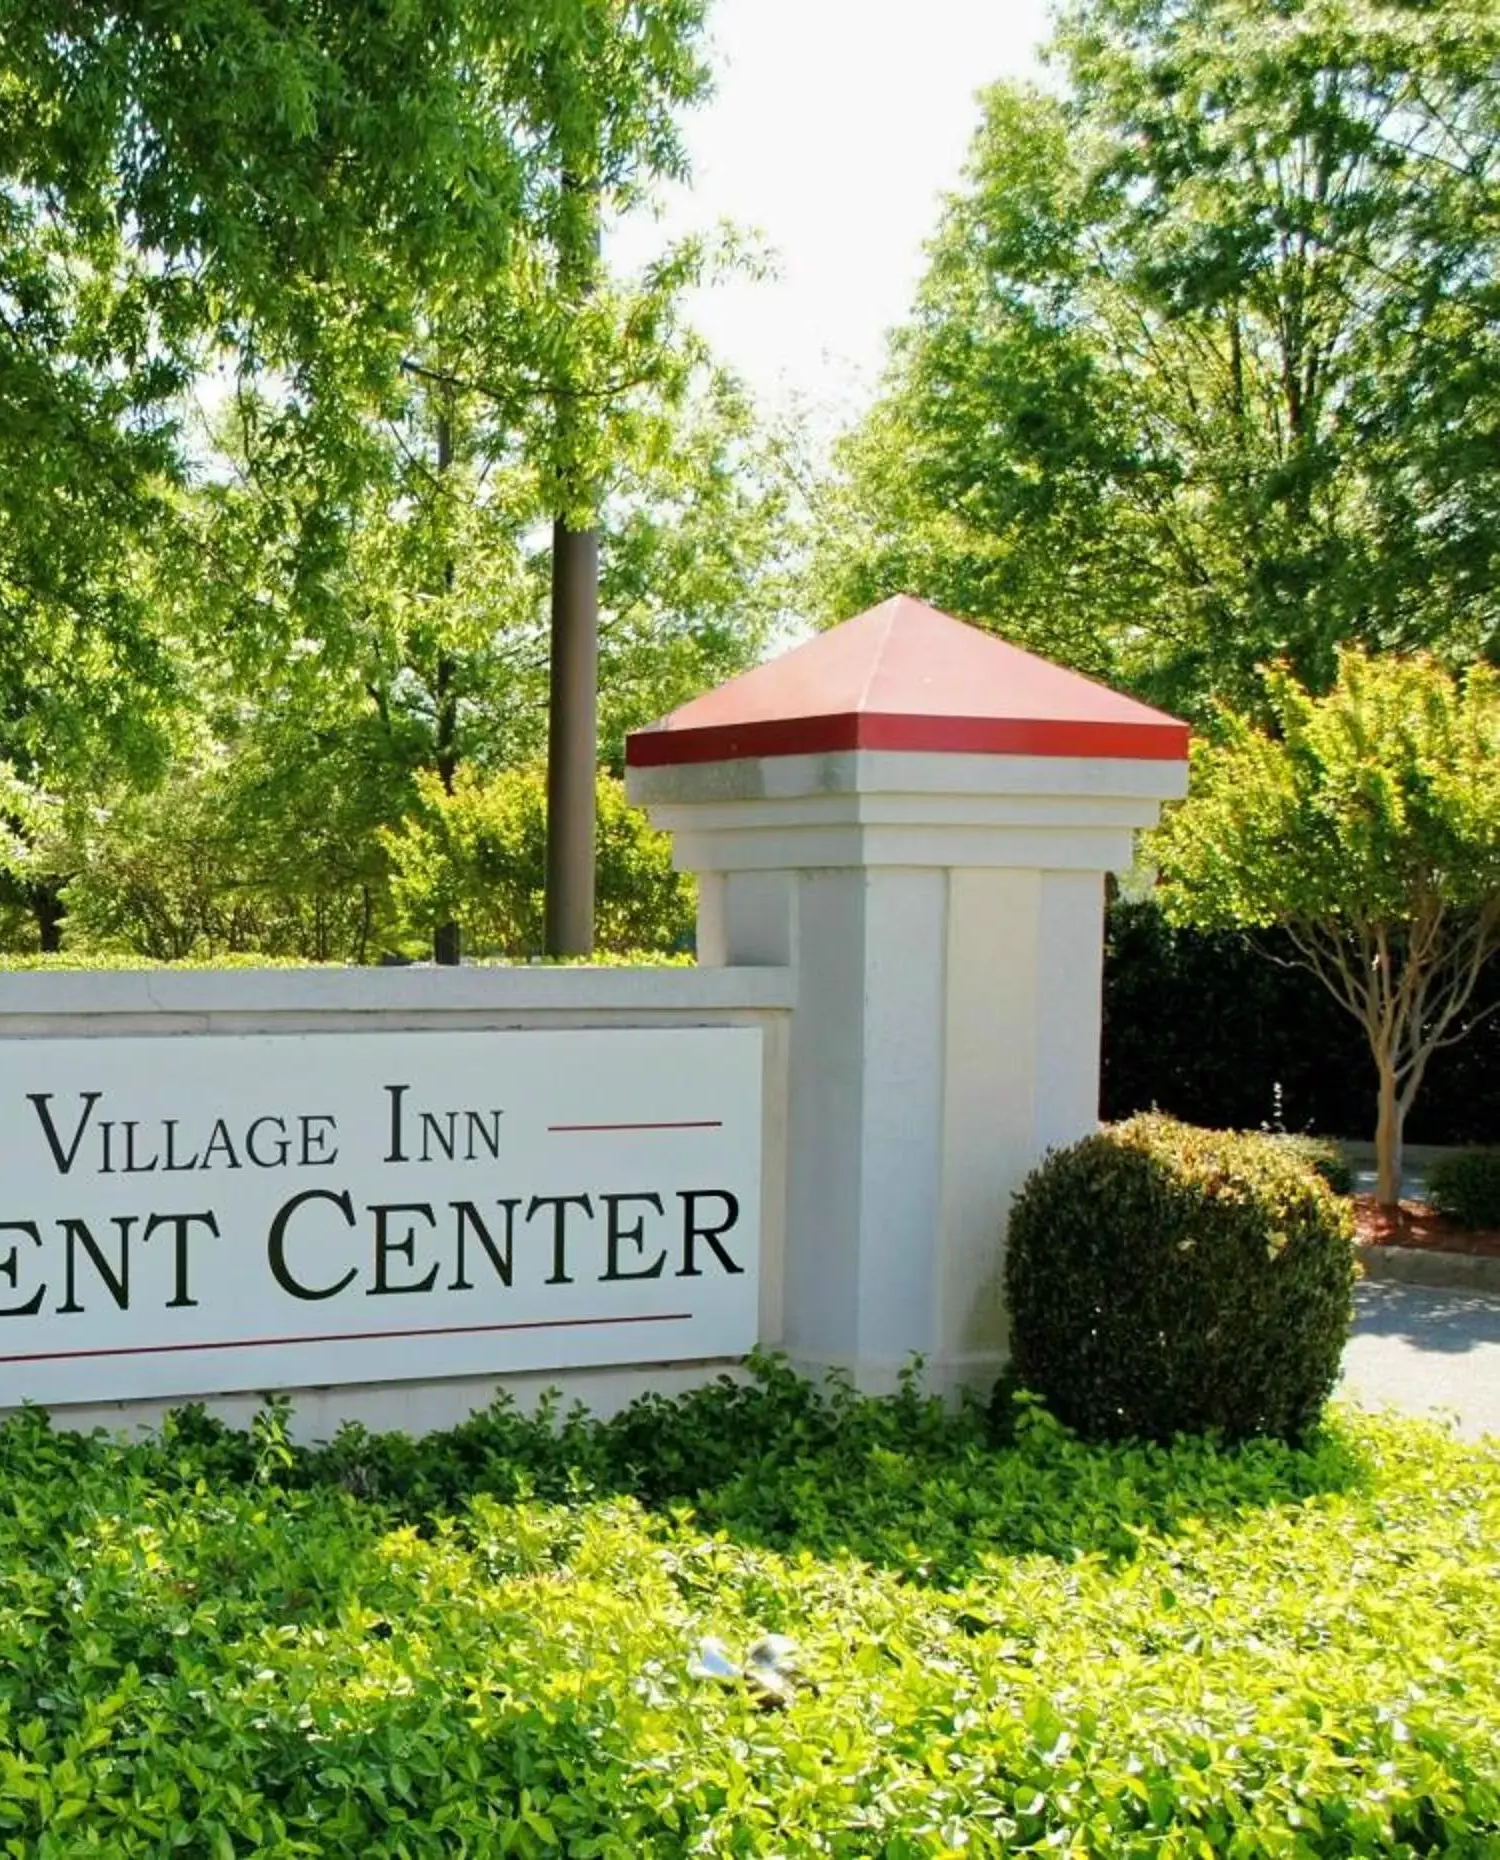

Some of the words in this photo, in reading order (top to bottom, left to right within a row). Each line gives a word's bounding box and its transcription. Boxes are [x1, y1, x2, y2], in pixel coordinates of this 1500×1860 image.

[26, 1091, 340, 1175] VILLAGE
[383, 1084, 504, 1163] INN
[267, 1188, 746, 1301] CENTER
